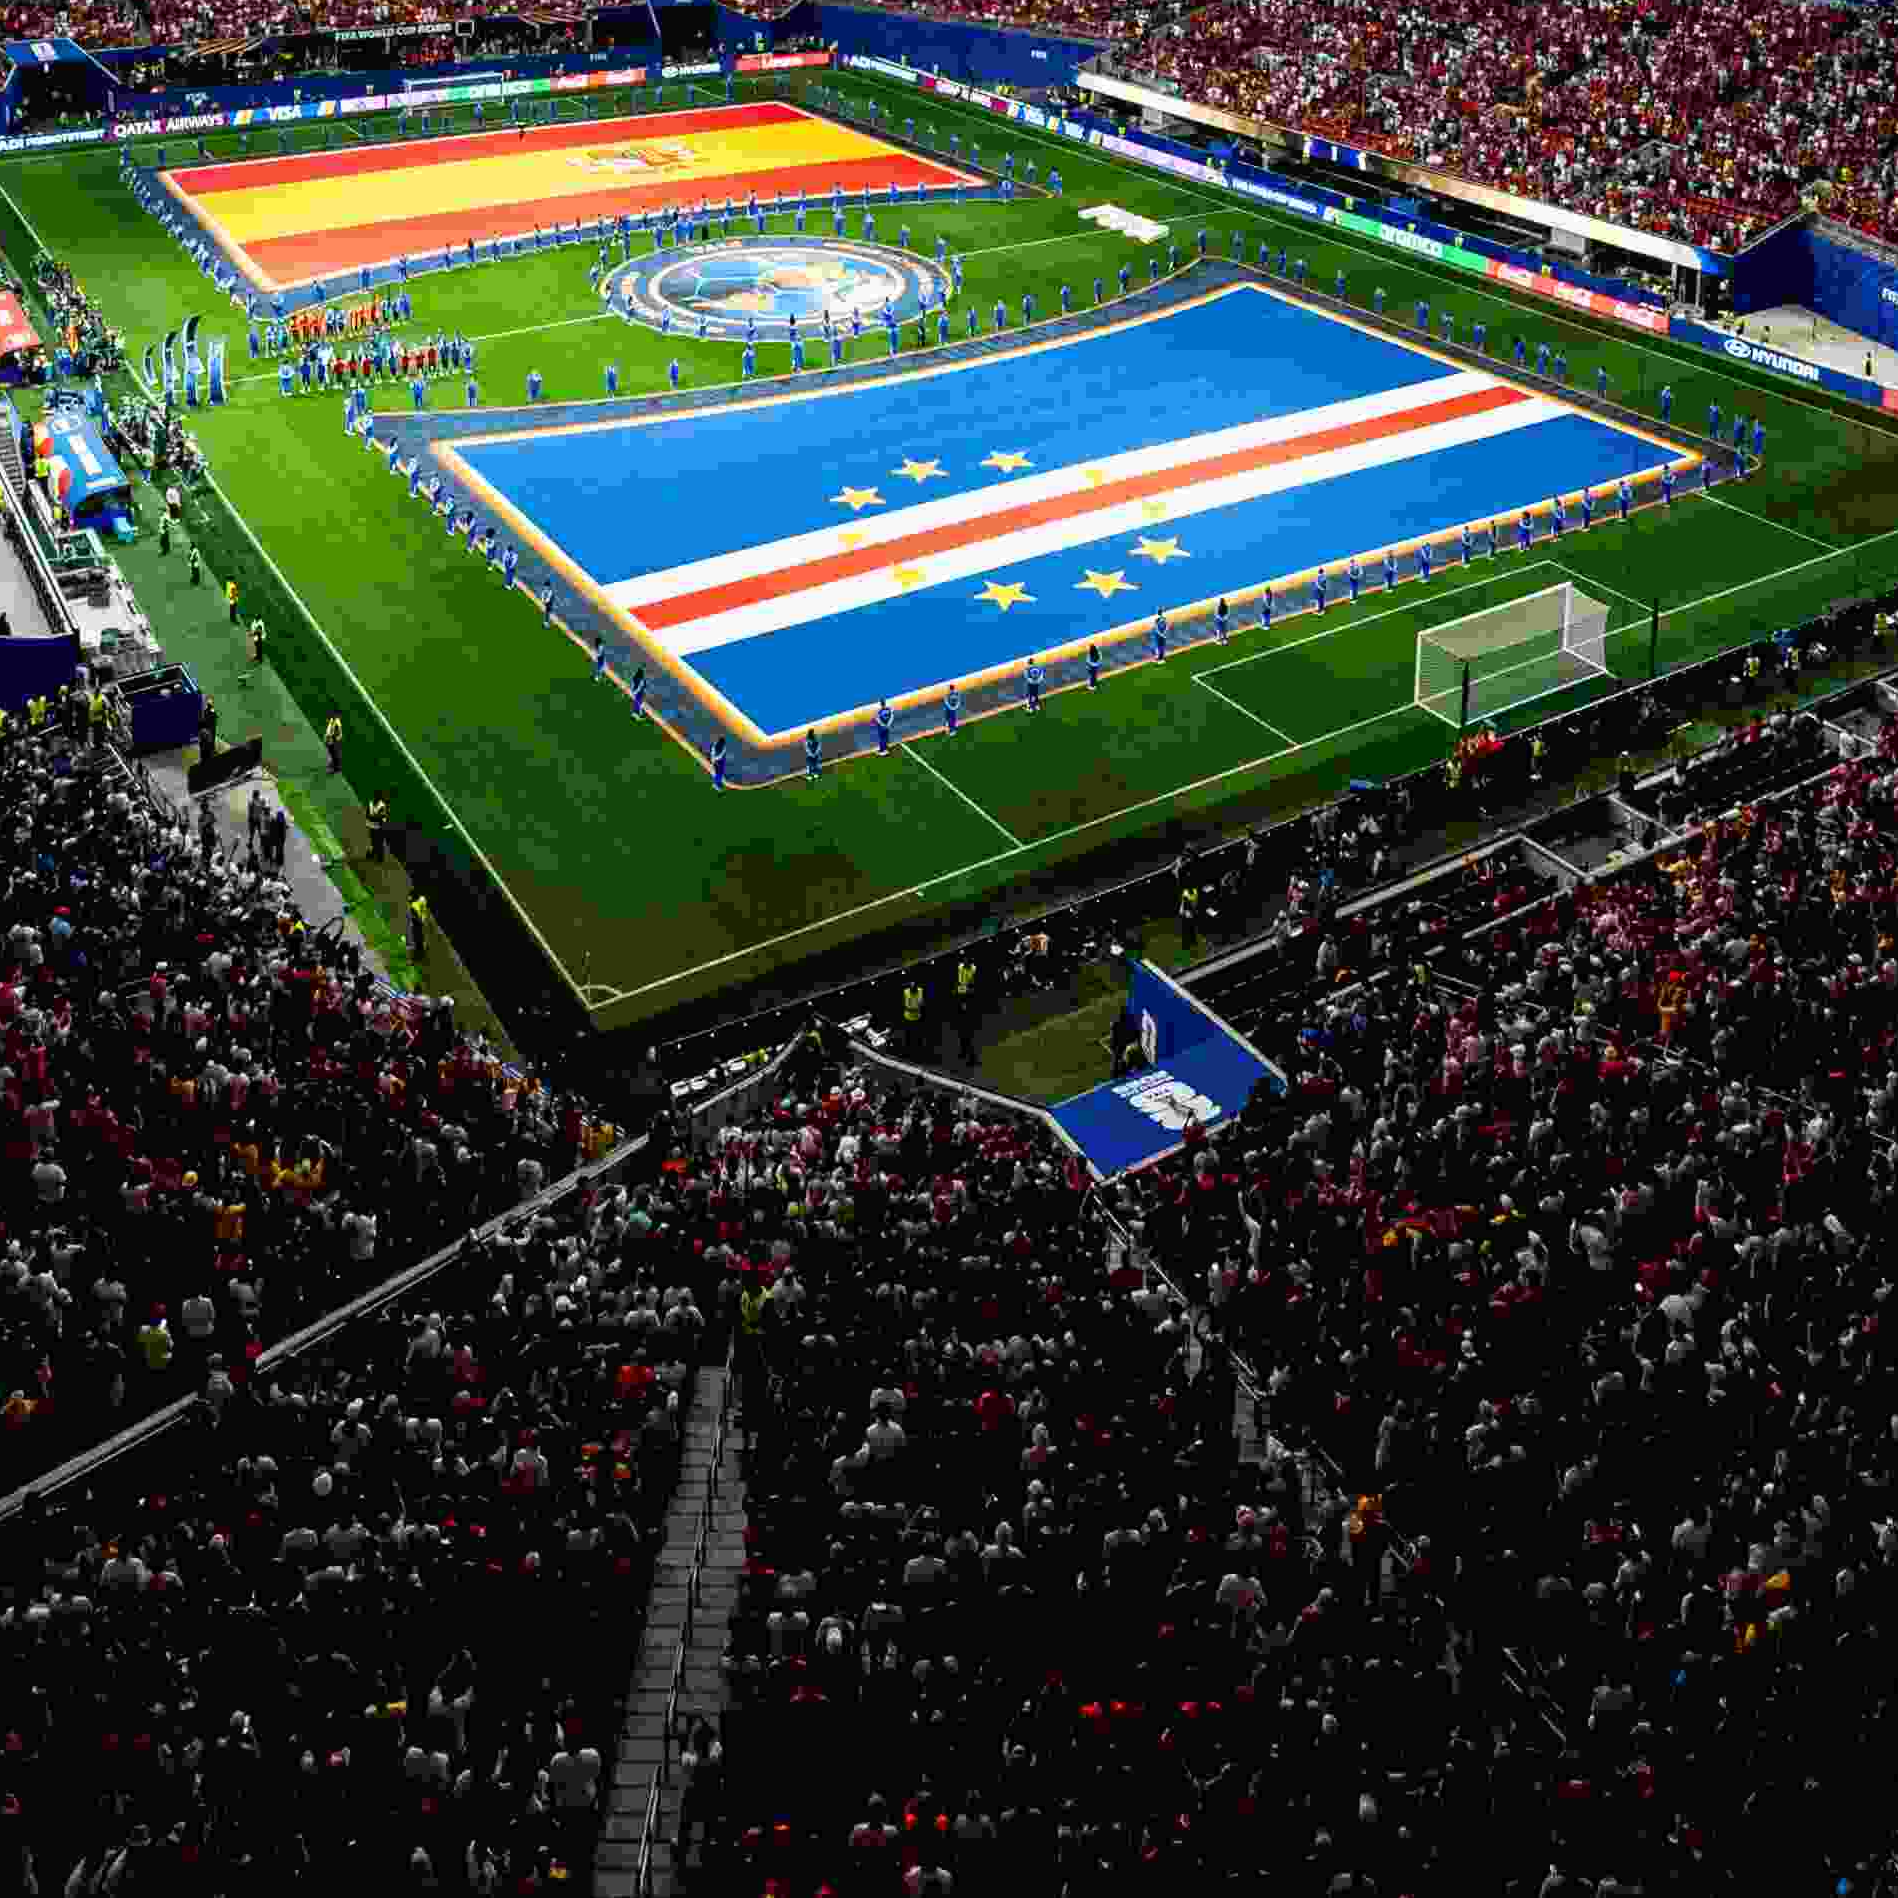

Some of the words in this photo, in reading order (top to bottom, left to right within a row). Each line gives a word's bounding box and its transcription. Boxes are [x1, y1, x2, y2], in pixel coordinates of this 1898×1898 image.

[268, 104, 302, 120] VISA
[114, 120, 162, 136] QATAR
[166, 114, 225, 133] AIRWAYS
[1751, 347, 1820, 381] HYUNDAI
